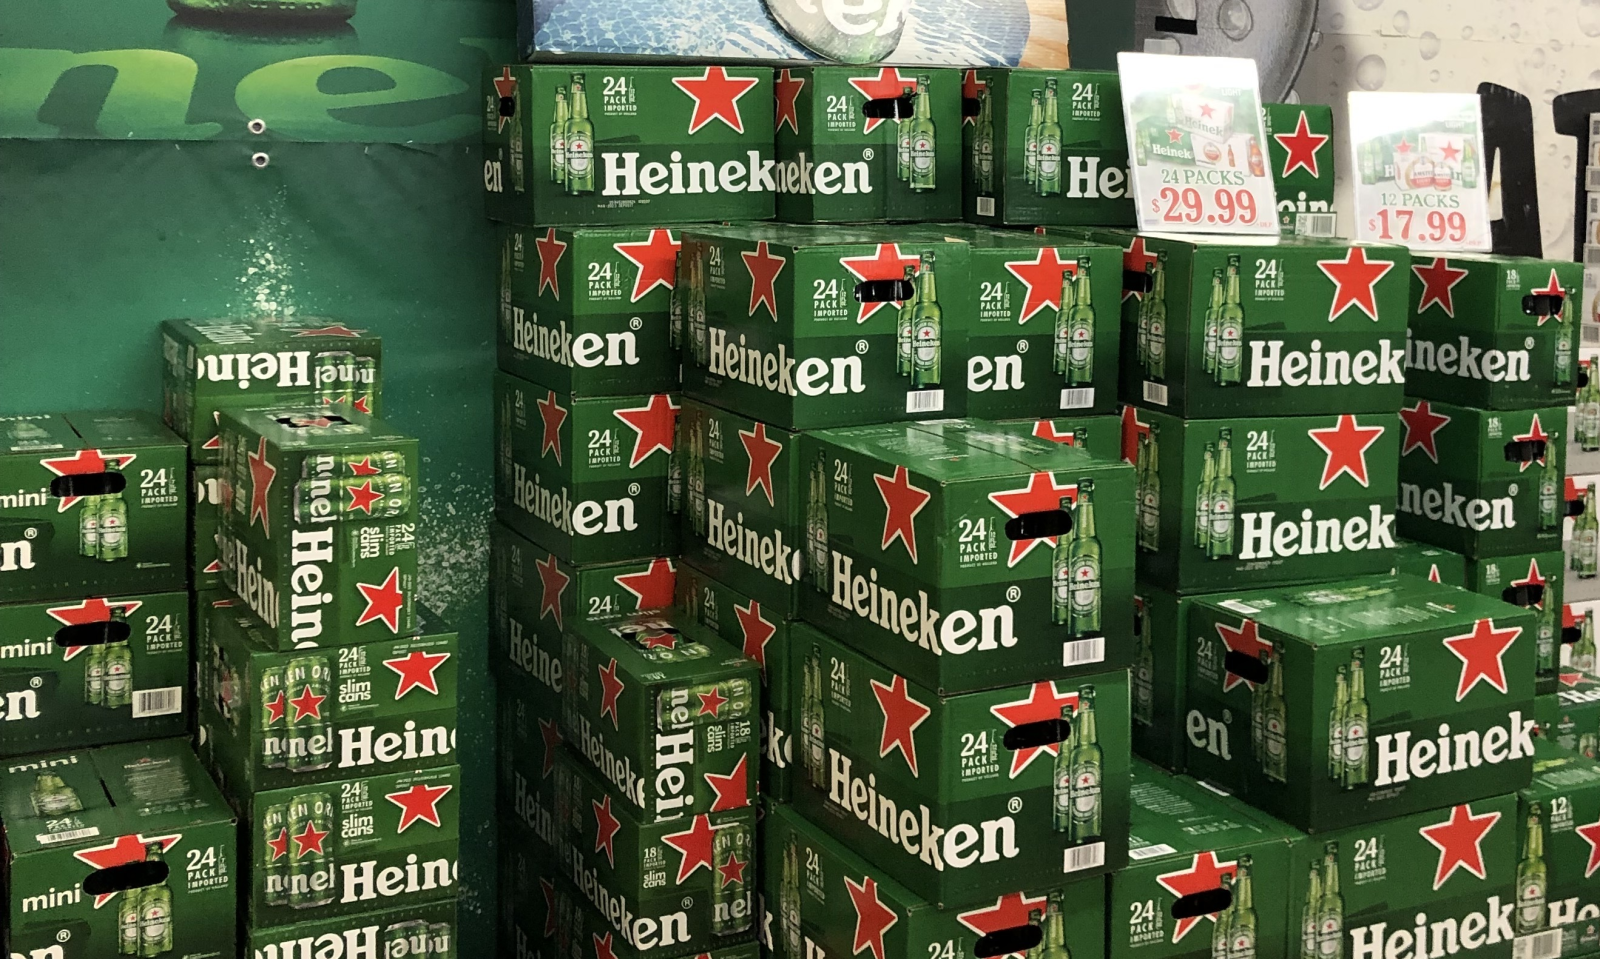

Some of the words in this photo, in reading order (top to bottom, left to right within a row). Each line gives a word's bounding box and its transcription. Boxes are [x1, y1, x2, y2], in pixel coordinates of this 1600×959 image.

[602, 76, 627, 95] 24
[1072, 83, 1092, 101] 24
[604, 96, 626, 104] PACK
[604, 104, 638, 112] IMPORTED
[826, 96, 848, 112] 24
[1072, 101, 1092, 110] PACK
[828, 112, 848, 121] PACK
[601, 150, 776, 196] Heinek
[1162, 168, 1180, 184] 24
[1184, 169, 1245, 186] PACKS
[1152, 186, 1258, 226] $29.99
[1380, 192, 1398, 206] 12
[1402, 193, 1460, 208] PACKS
[1368, 208, 1466, 243] $17.99
[710, 246, 721, 266] 24
[588, 262, 612, 281] 24
[1254, 258, 1277, 278] 24
[589, 281, 612, 290] PACK
[813, 278, 838, 300] 24
[980, 282, 1002, 300] 24
[1256, 280, 1276, 288] PACK
[814, 300, 838, 308] PACK
[980, 301, 1002, 310] PACK
[980, 310, 1011, 318] IMPORTED
[198, 351, 311, 390] Hein
[1247, 339, 1405, 388] Heinek
[709, 418, 720, 438] 24
[588, 430, 612, 448] 24
[1246, 431, 1268, 451] 24
[588, 456, 620, 464] IMPORTED
[589, 448, 611, 456] PACK
[1248, 452, 1268, 460] PACK
[834, 458, 848, 484] 24
[1246, 460, 1276, 468] IMPORTED
[140, 468, 167, 488] 24
[141, 488, 166, 496] PACK
[834, 482, 848, 494] PACK
[141, 495, 178, 504] IMPORTED
[402, 523, 416, 542] 24
[958, 518, 987, 542] 24
[1239, 504, 1396, 560] Heinek
[360, 527, 370, 558] cans
[370, 527, 384, 558] slim
[960, 542, 986, 554] PACK
[960, 552, 998, 562] IMPORTED
[292, 527, 334, 649] Hein
[589, 596, 612, 614] 24
[704, 587, 716, 608] 24
[146, 614, 172, 634] 24
[146, 634, 172, 644] PACK
[146, 641, 183, 650] IMPORTED
[0, 636, 52, 659] mini
[338, 647, 358, 662] 24
[1196, 637, 1212, 660] 24
[1380, 645, 1402, 670] 24
[340, 666, 371, 674] IMPORTED
[830, 658, 846, 684] 24
[1380, 668, 1401, 678] PACK
[340, 679, 371, 694] slim
[831, 682, 846, 694] PACK
[1380, 676, 1411, 688] IMPORTED
[339, 691, 372, 703] cans
[739, 720, 750, 736] 18
[338, 720, 456, 768] Hein
[707, 726, 716, 753] cans
[715, 724, 726, 752] slim
[960, 732, 988, 756] 24
[1374, 711, 1535, 788] Heinek
[8, 756, 78, 774] mini
[962, 756, 988, 766] PACK
[656, 729, 694, 823] Hei
[962, 764, 1000, 777] IMPORTED
[342, 783, 361, 798] 24
[342, 801, 374, 810] IMPORTED
[1551, 798, 1567, 815] 12
[342, 814, 374, 829] slim
[341, 826, 374, 838] cans
[644, 848, 656, 858] 18
[1354, 838, 1378, 862] 24
[186, 847, 217, 872] 24
[806, 847, 820, 870] 24
[1354, 860, 1376, 872] PACK
[188, 870, 216, 880] PACK
[188, 876, 228, 888] IMPORTED
[341, 854, 458, 904] Hein
[644, 870, 666, 882] slim
[1354, 868, 1387, 880] IMPORTED
[643, 877, 666, 888] cans
[22, 883, 81, 912] mini
[1130, 900, 1154, 924] 24
[1130, 922, 1154, 933] PACK
[1130, 930, 1164, 943] IMPORTED
